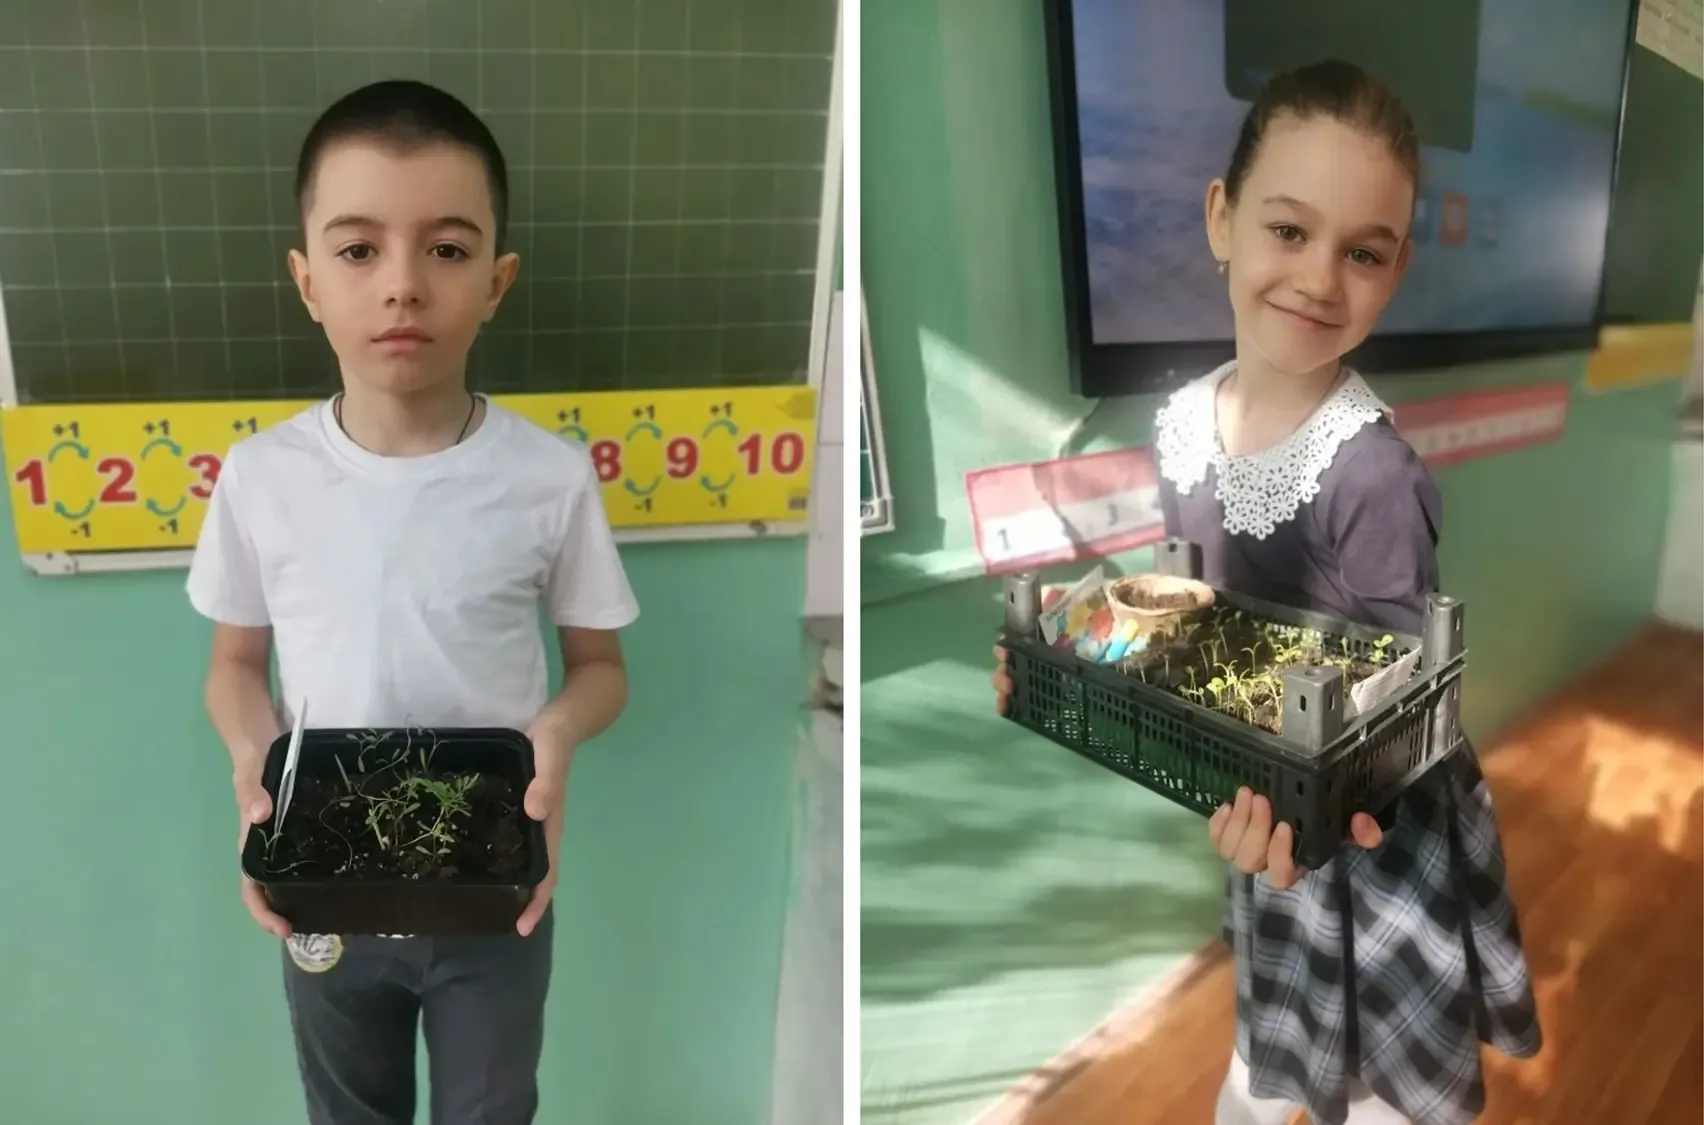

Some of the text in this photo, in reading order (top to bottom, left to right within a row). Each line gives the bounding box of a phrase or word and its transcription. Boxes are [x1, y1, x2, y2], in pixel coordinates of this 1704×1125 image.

[53, 402, 733, 438] +1 +1 +1 +1 +1 +1
[16, 433, 804, 505] 1 2 3 8 9 10
[71, 493, 728, 538] -1 -1 -1 -1
